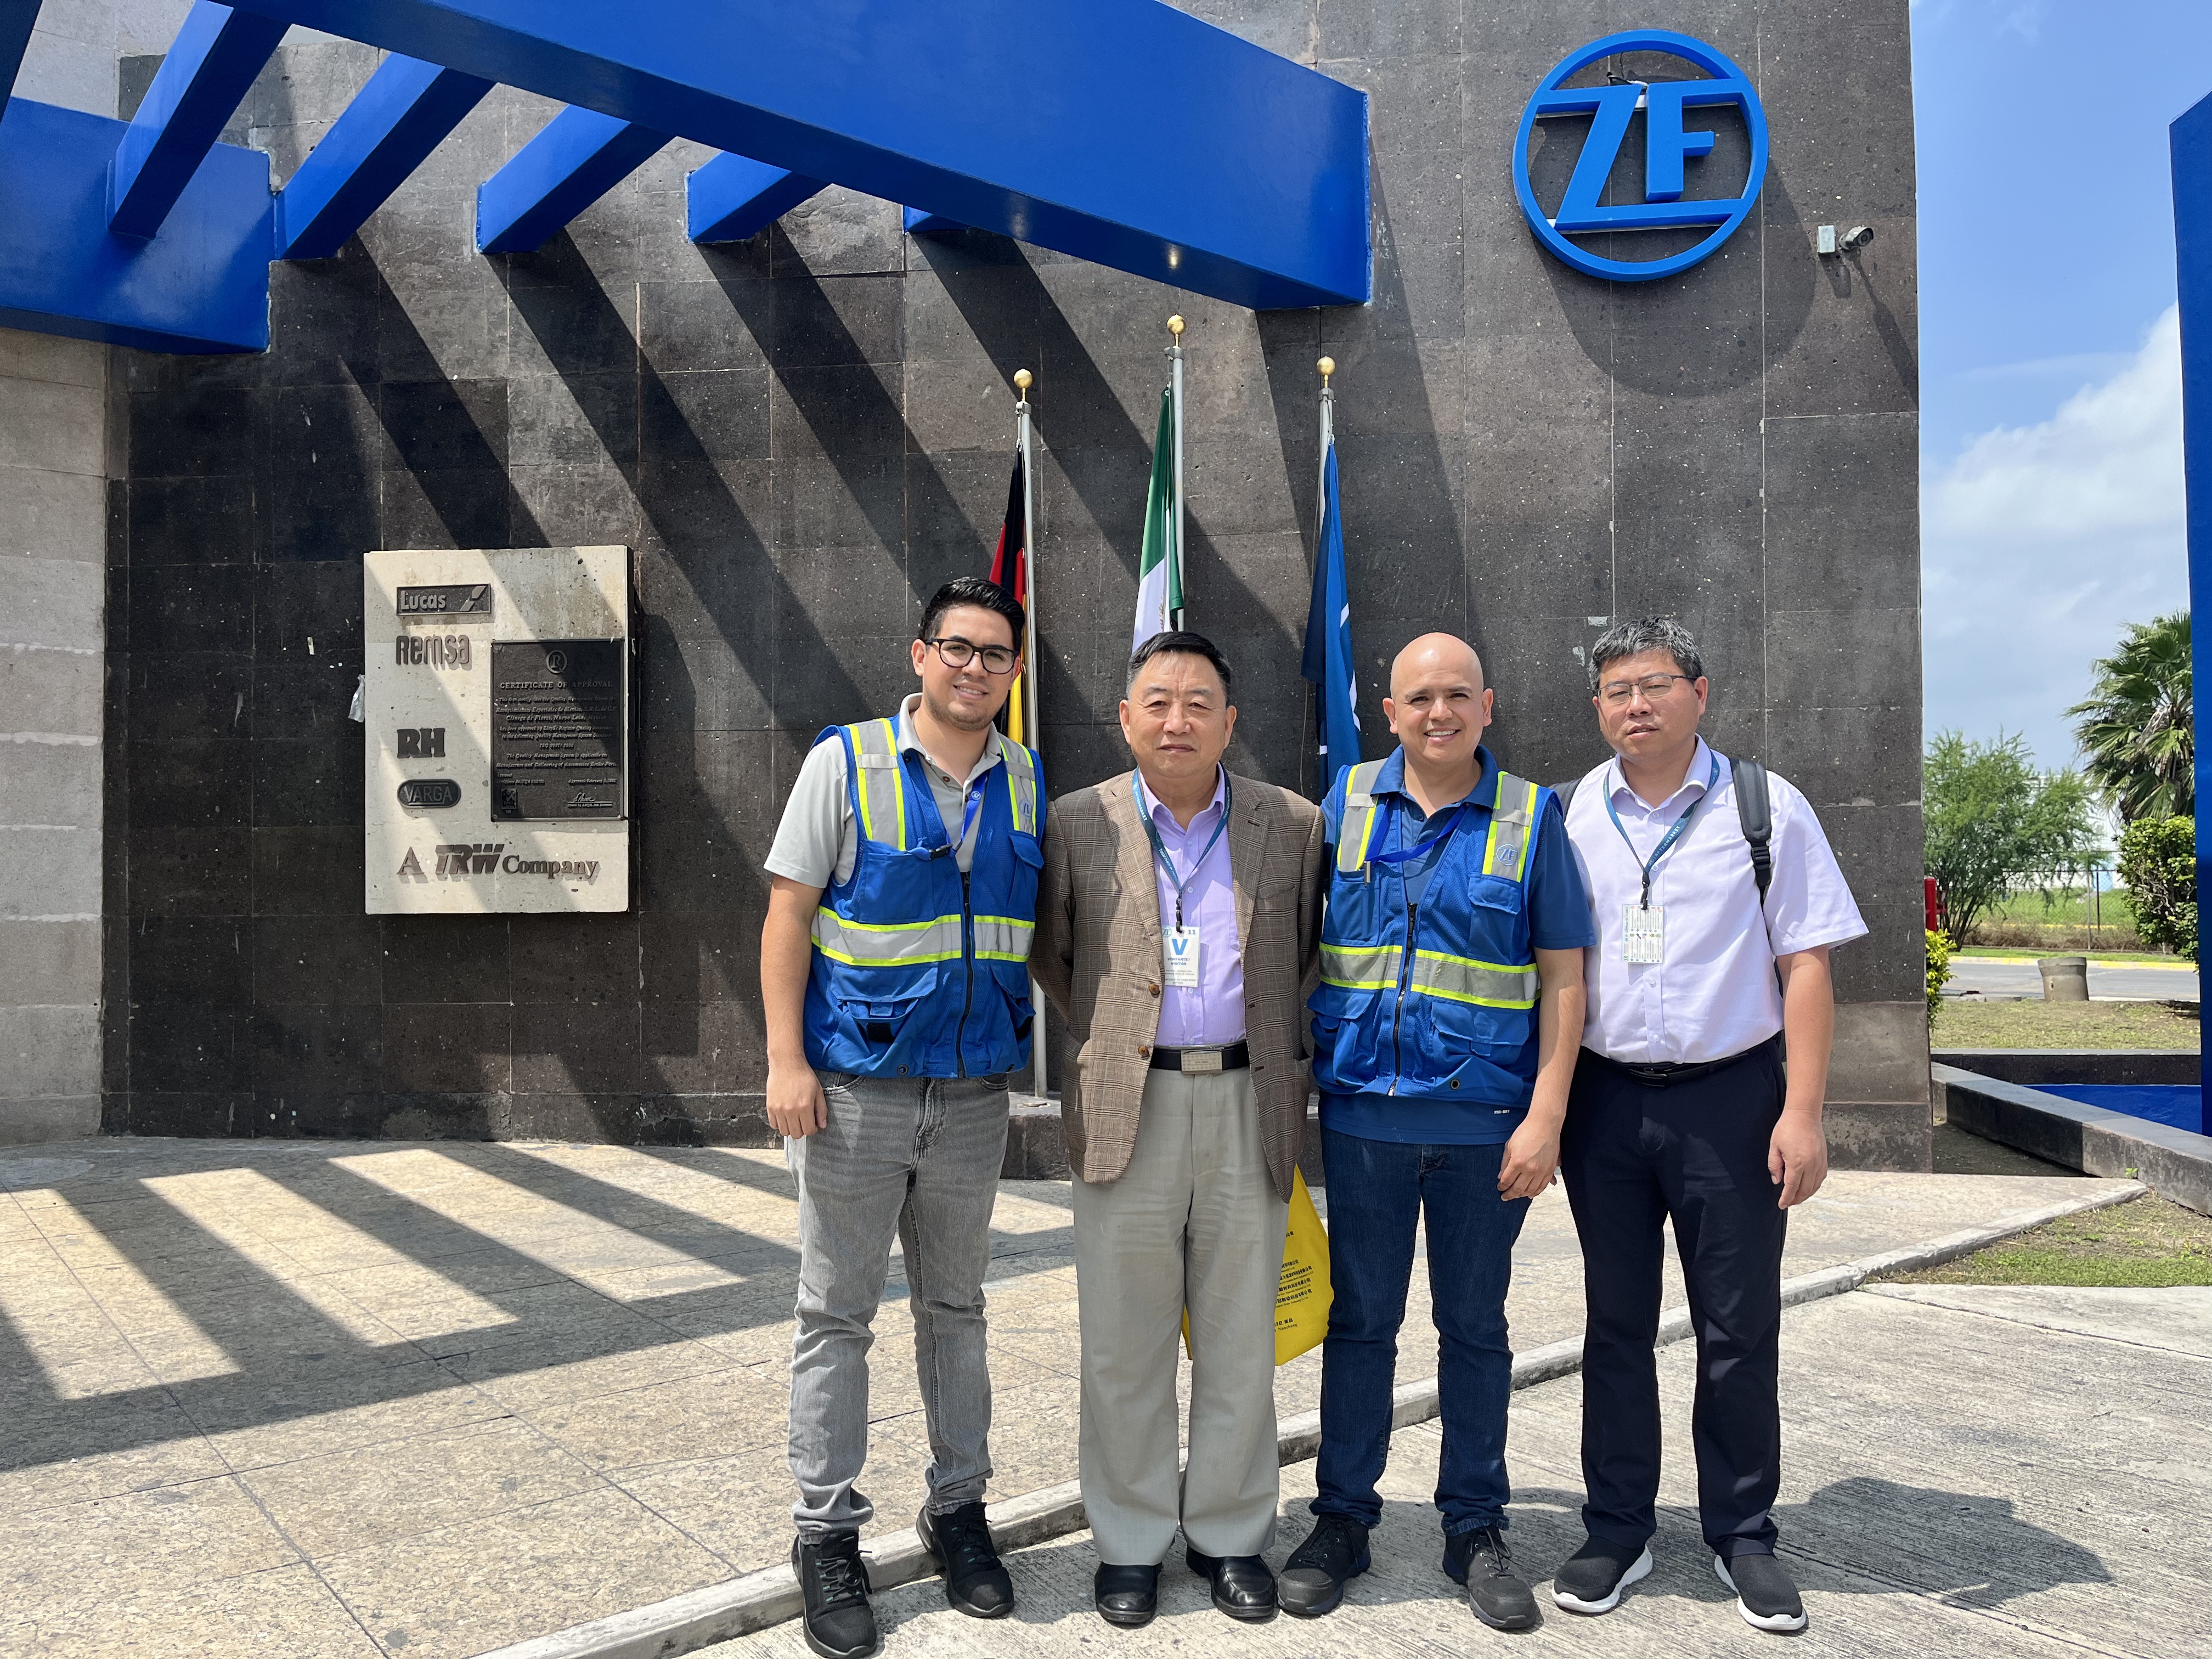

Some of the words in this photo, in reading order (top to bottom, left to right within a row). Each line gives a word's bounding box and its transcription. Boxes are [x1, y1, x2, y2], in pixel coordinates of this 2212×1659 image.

[400, 590, 446, 610] Lucas
[396, 728, 445, 759] RH
[404, 783, 453, 804] VARGA
[1654, 826, 1680, 857] AFTERMARKET
[397, 846, 424, 875] A
[435, 844, 505, 874] TRW
[502, 855, 599, 879] Company
[1171, 939, 1188, 955] V
